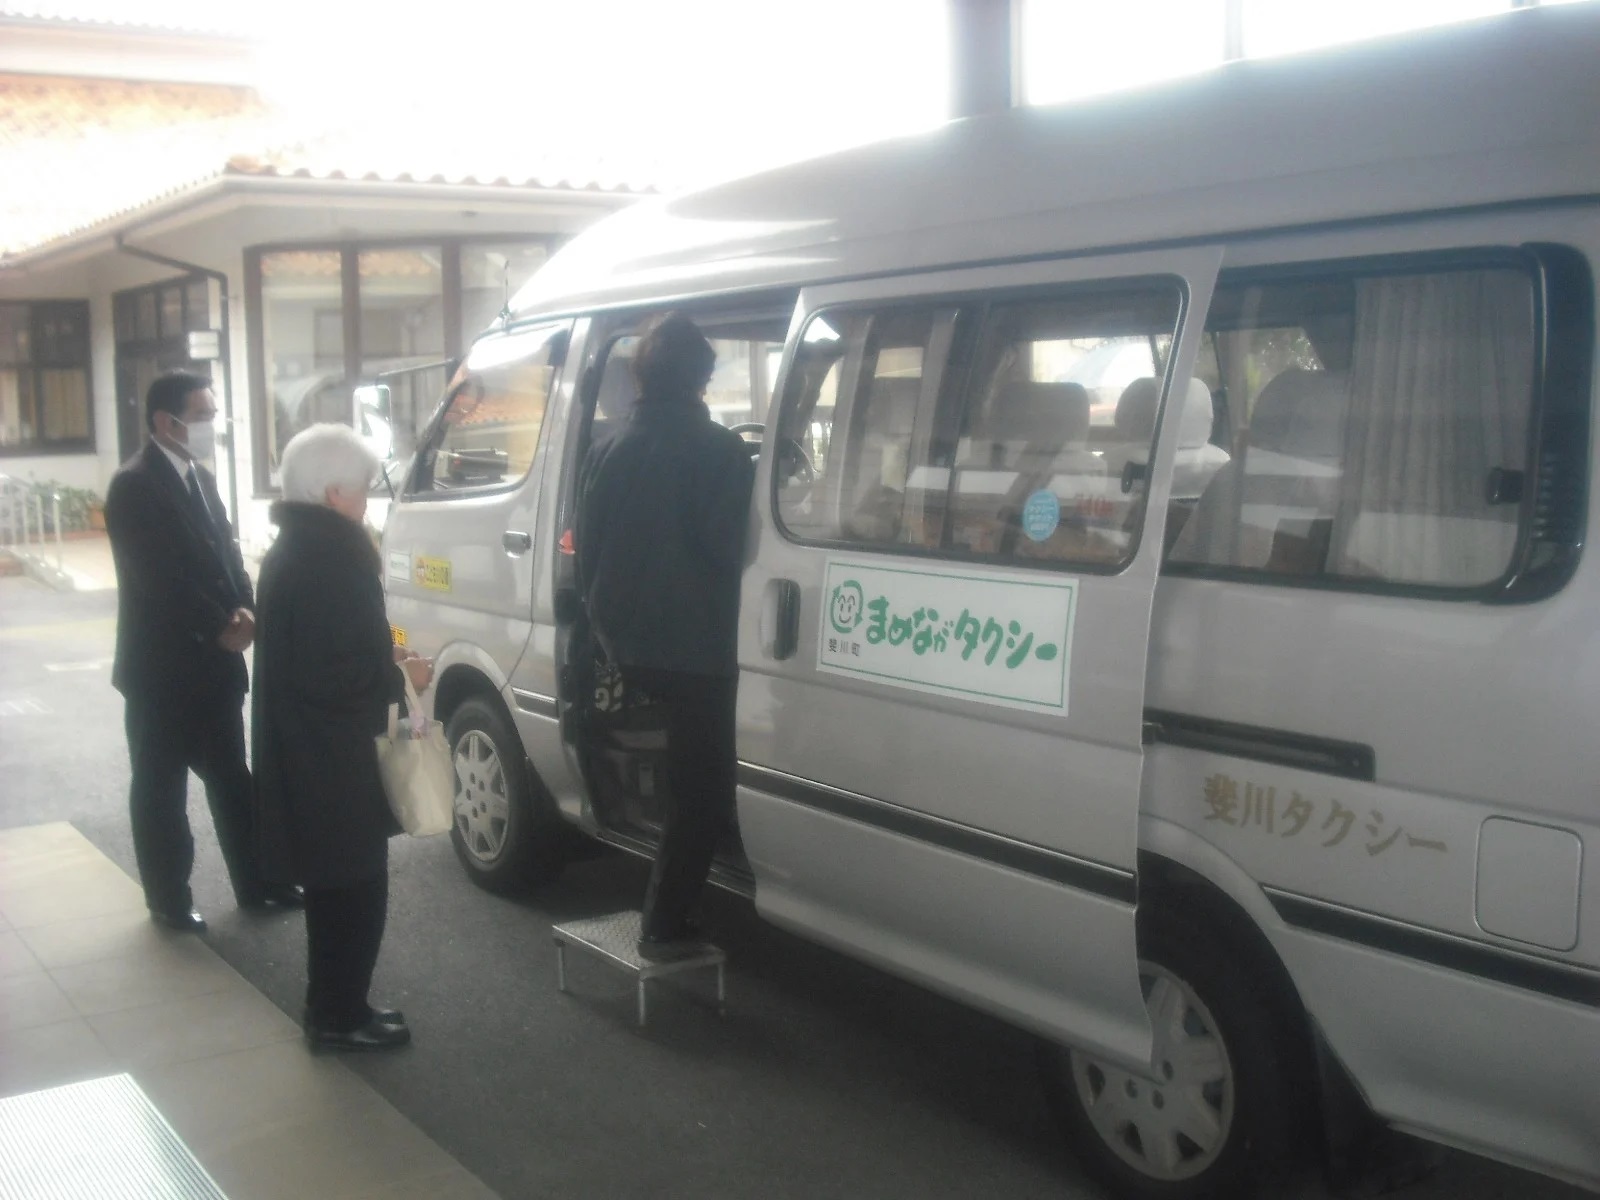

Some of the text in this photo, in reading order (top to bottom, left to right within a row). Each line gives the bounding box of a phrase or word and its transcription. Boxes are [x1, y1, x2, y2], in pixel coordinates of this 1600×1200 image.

[1203, 773, 1448, 857] 斐川タクシー
